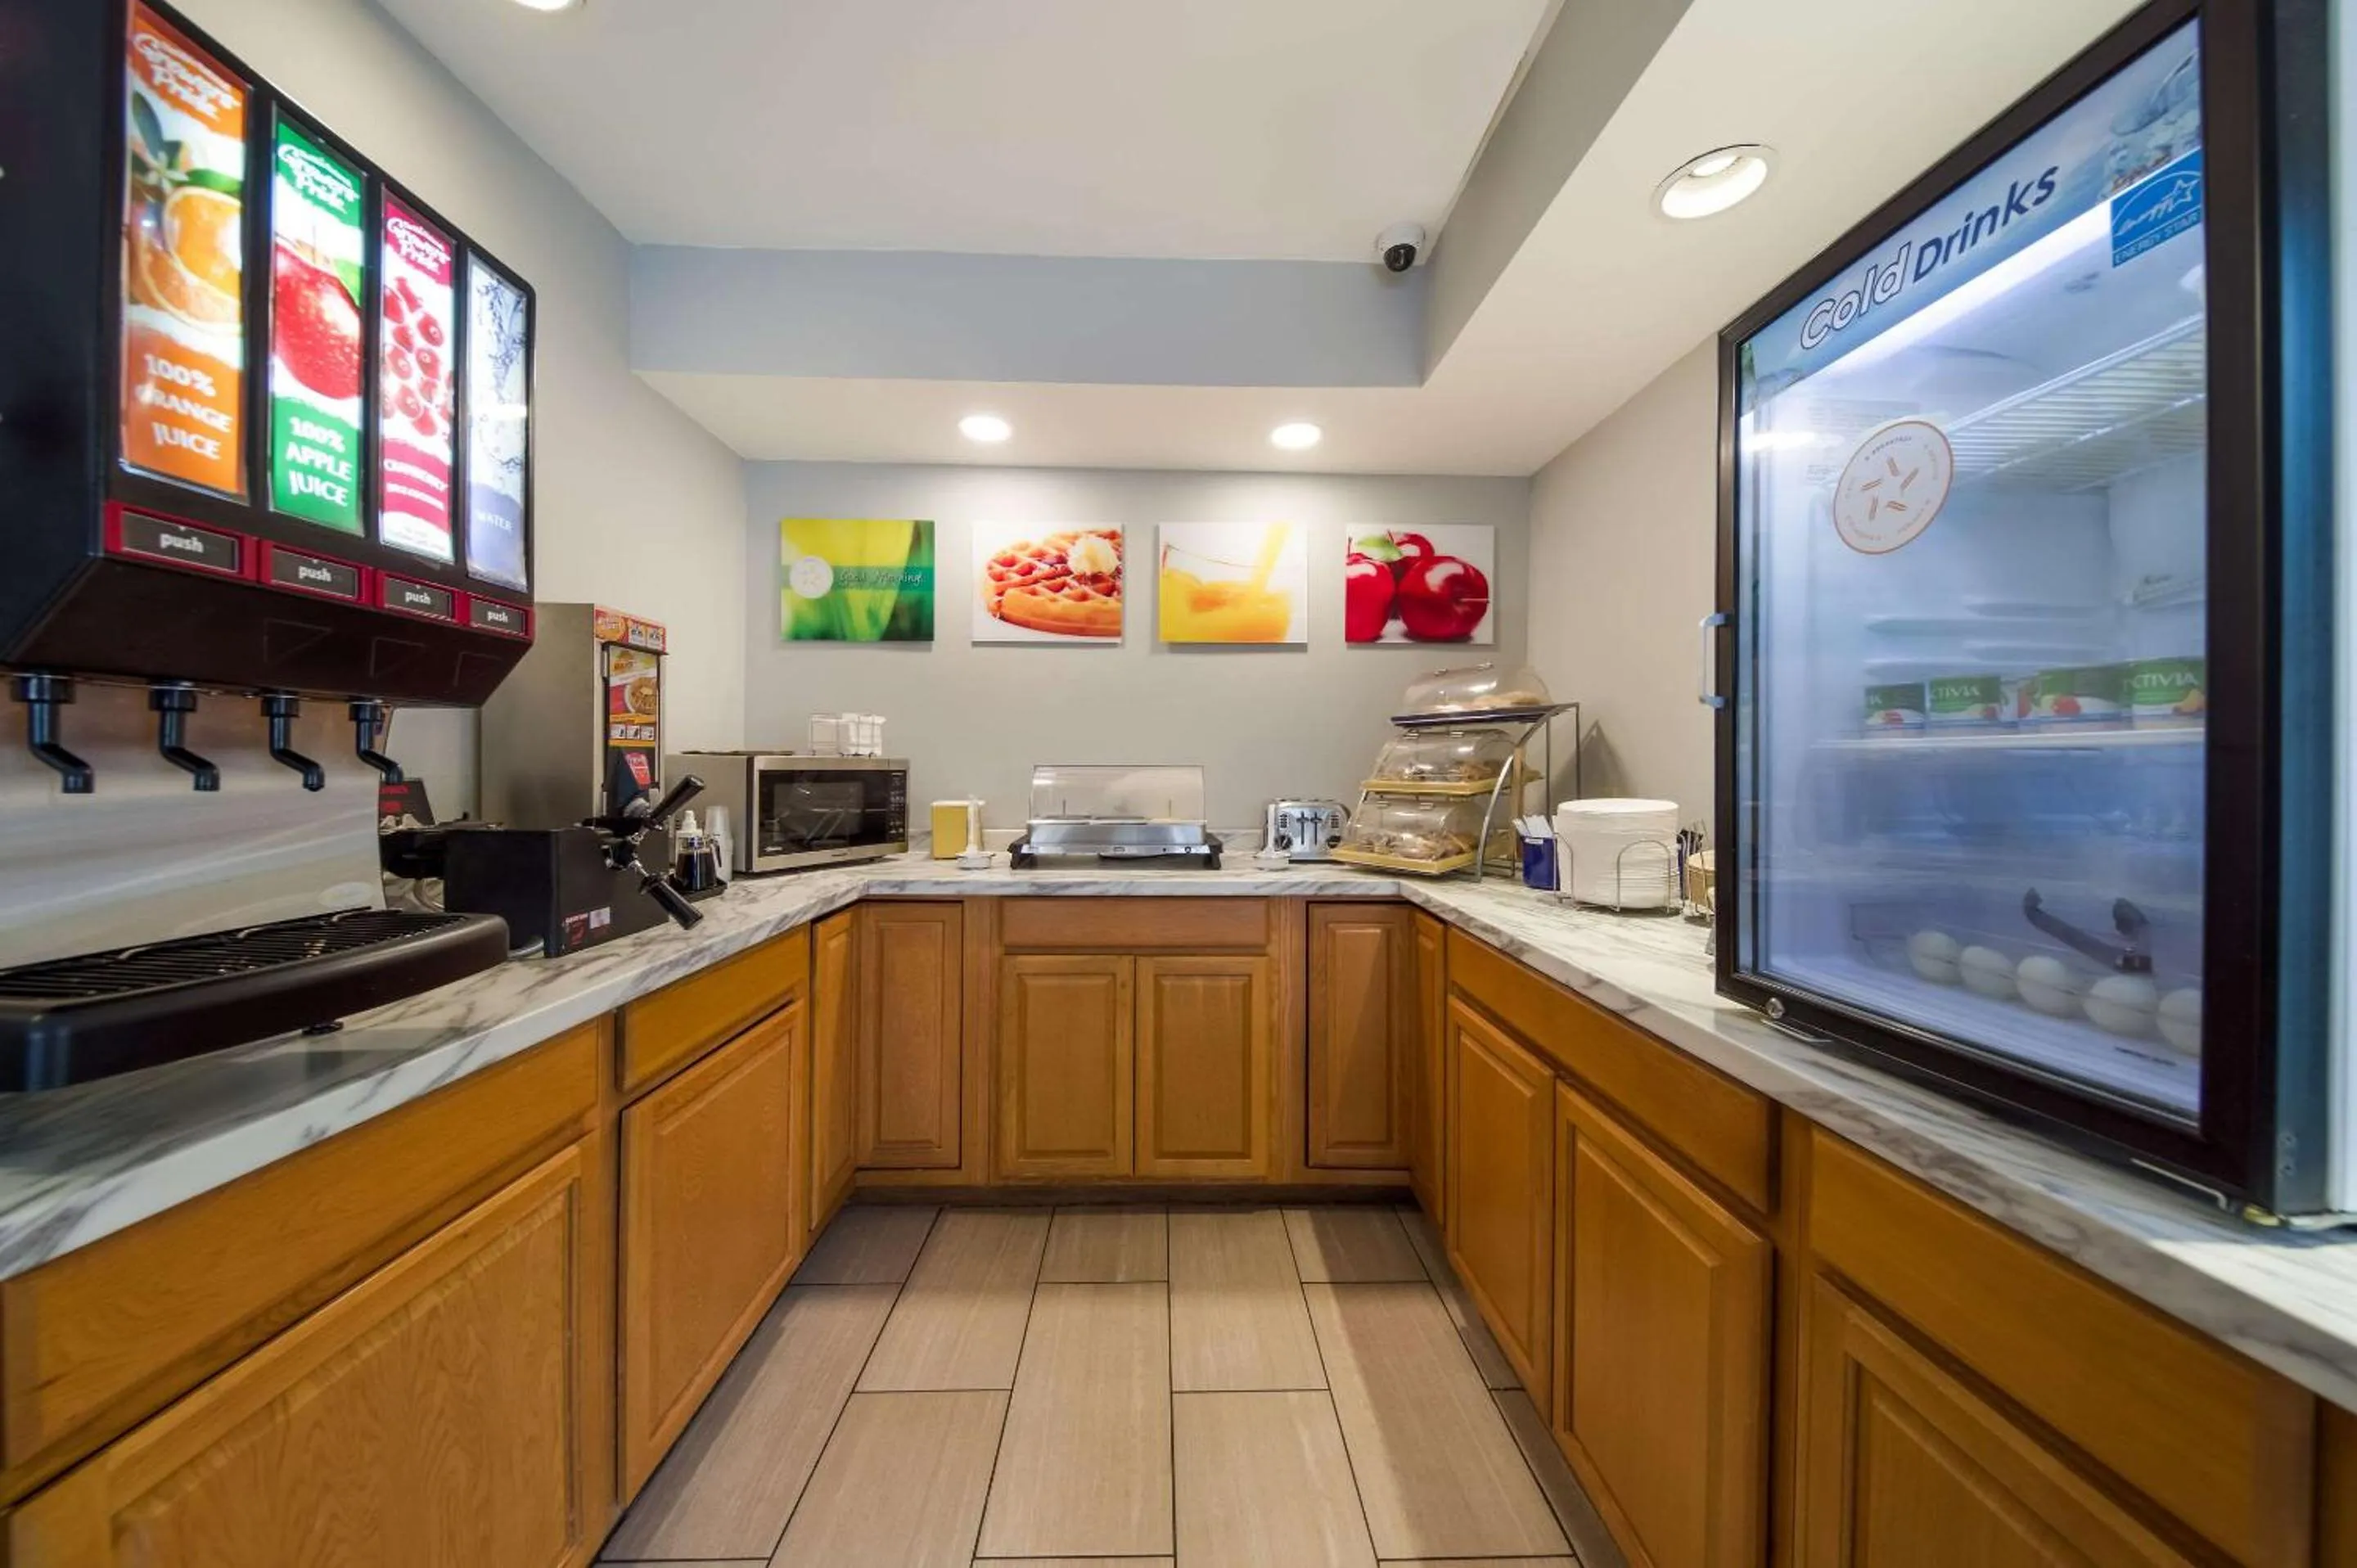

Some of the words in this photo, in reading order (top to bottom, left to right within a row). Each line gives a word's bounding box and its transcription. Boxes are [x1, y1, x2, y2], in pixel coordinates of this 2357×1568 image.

[1800, 241, 1912, 350] Cold
[1912, 165, 2058, 283] Drinks
[144, 354, 217, 397] 100%
[152, 421, 221, 460] JUICE
[289, 417, 346, 453] 100%
[286, 442, 352, 482] APPLE
[288, 469, 349, 507] JUICE
[160, 534, 204, 553] push
[298, 565, 331, 583] push
[404, 591, 431, 605] push
[487, 611, 508, 623] push
